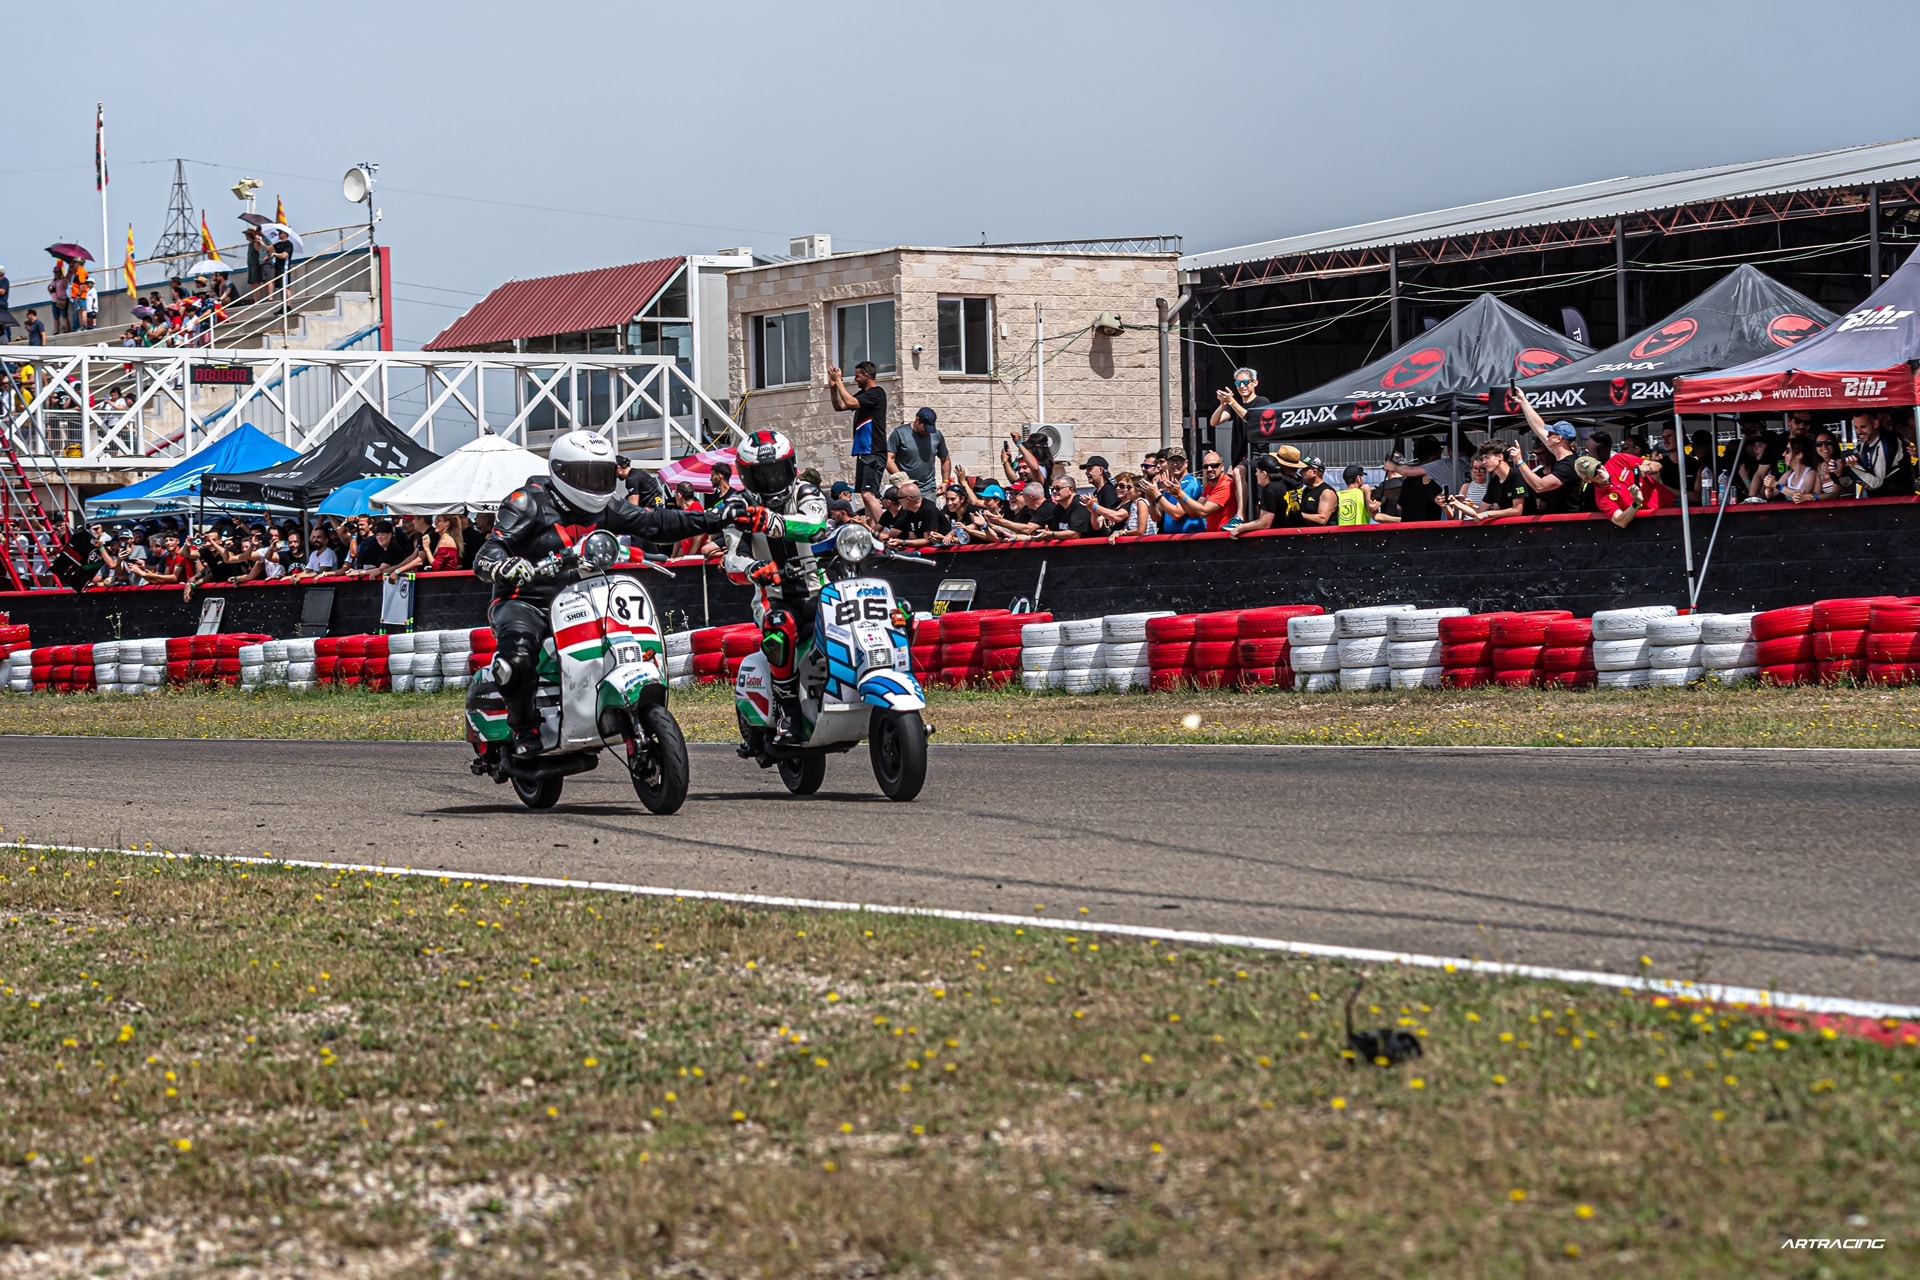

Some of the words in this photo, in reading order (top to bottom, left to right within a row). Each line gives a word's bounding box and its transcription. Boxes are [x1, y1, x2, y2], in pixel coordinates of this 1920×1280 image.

[1836, 305, 1915, 332] Bihr
[1631, 381, 1674, 400] 24M
[1772, 385, 1833, 400] www.bihr.eu
[1841, 376, 1888, 397] Bihr
[1526, 387, 1588, 409] 24MX
[1280, 404, 1339, 429] 24MX
[567, 611, 587, 620] SHOEI
[615, 596, 645, 621] 87
[835, 598, 888, 626] 86
